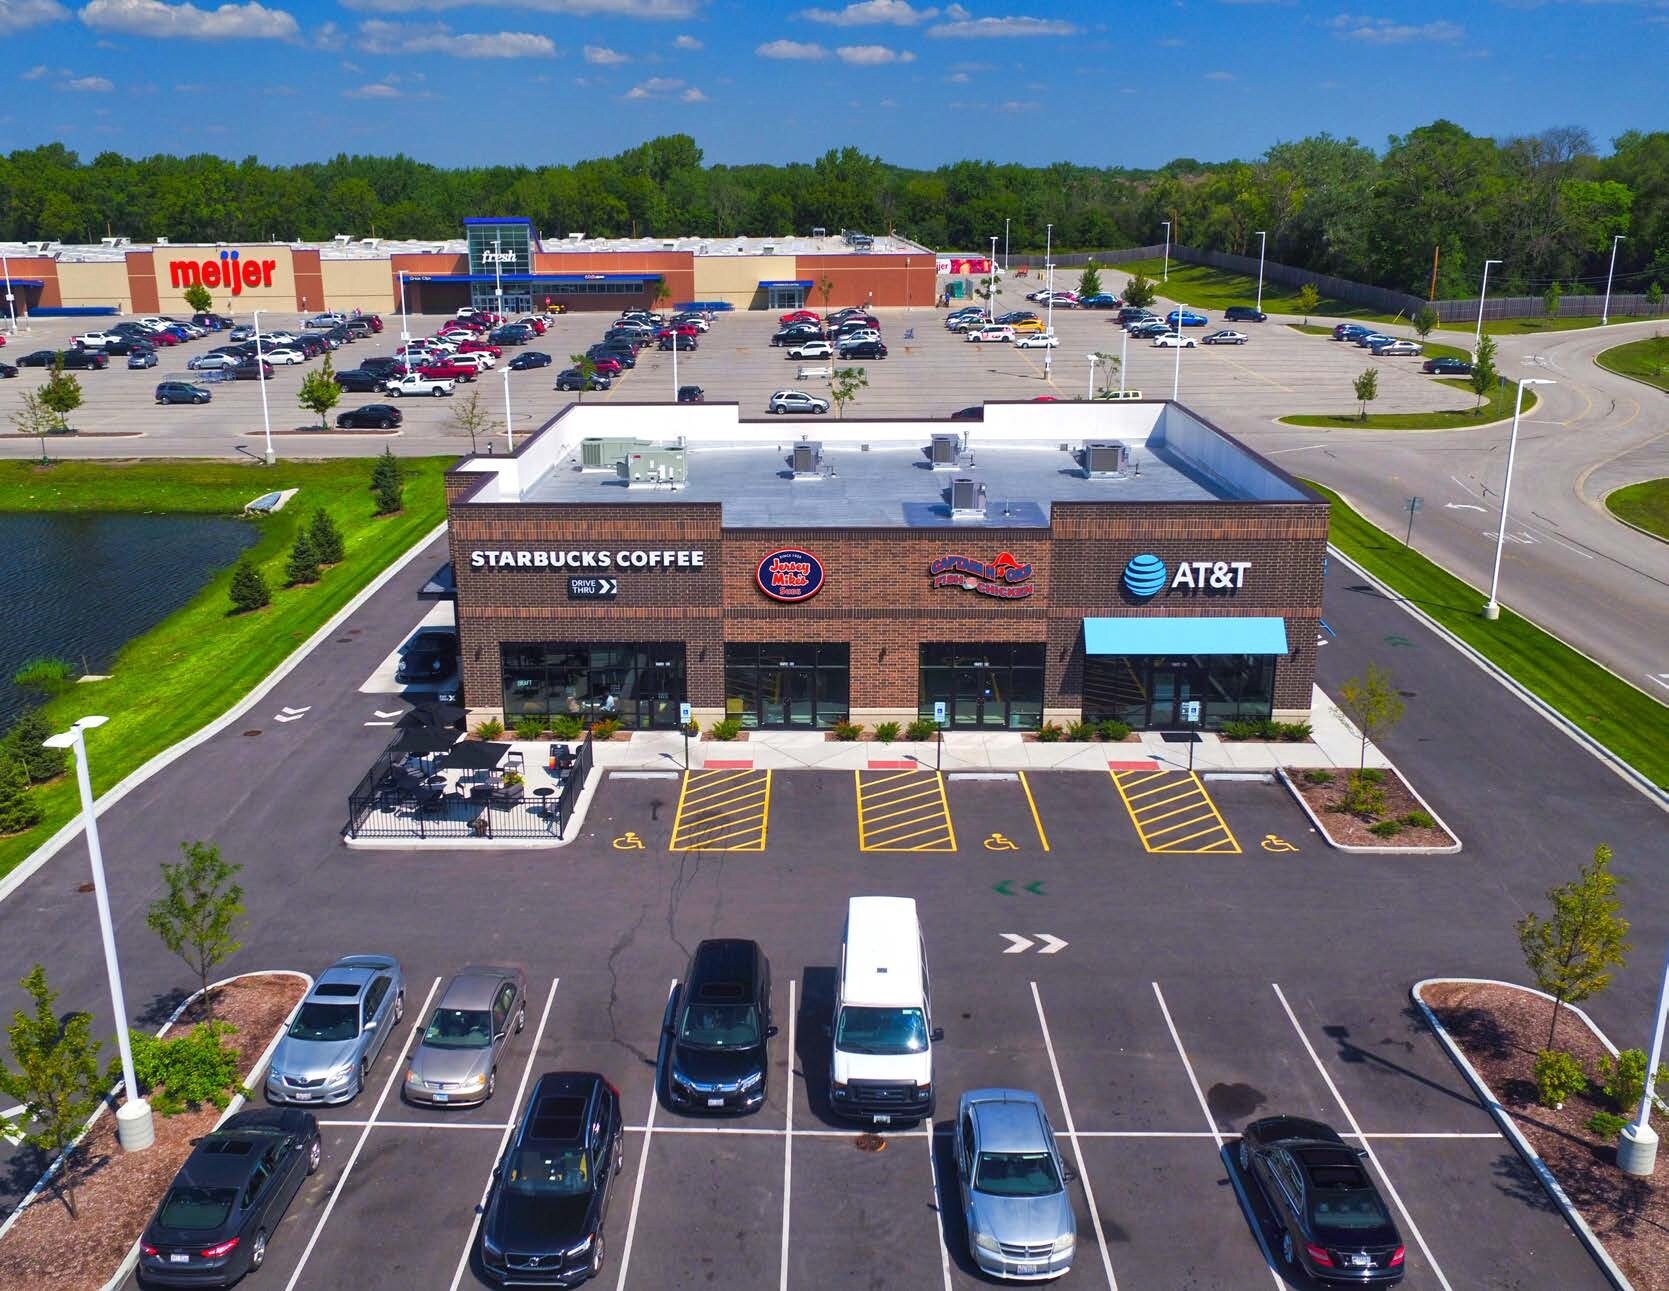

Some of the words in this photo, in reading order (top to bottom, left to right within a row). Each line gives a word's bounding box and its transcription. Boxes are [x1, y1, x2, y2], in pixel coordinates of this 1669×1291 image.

[482, 249, 517, 264] fresh
[169, 250, 276, 296] meijer
[471, 551, 611, 567] STARBUCKS
[616, 551, 704, 567] COFFEE
[769, 558, 810, 576] Jersey
[931, 555, 985, 579] CAPTAIN
[771, 572, 809, 587] Mike's
[1171, 561, 1252, 588] AT&T
[934, 573, 965, 588] FISH
[977, 582, 1034, 598] CHICKEN
